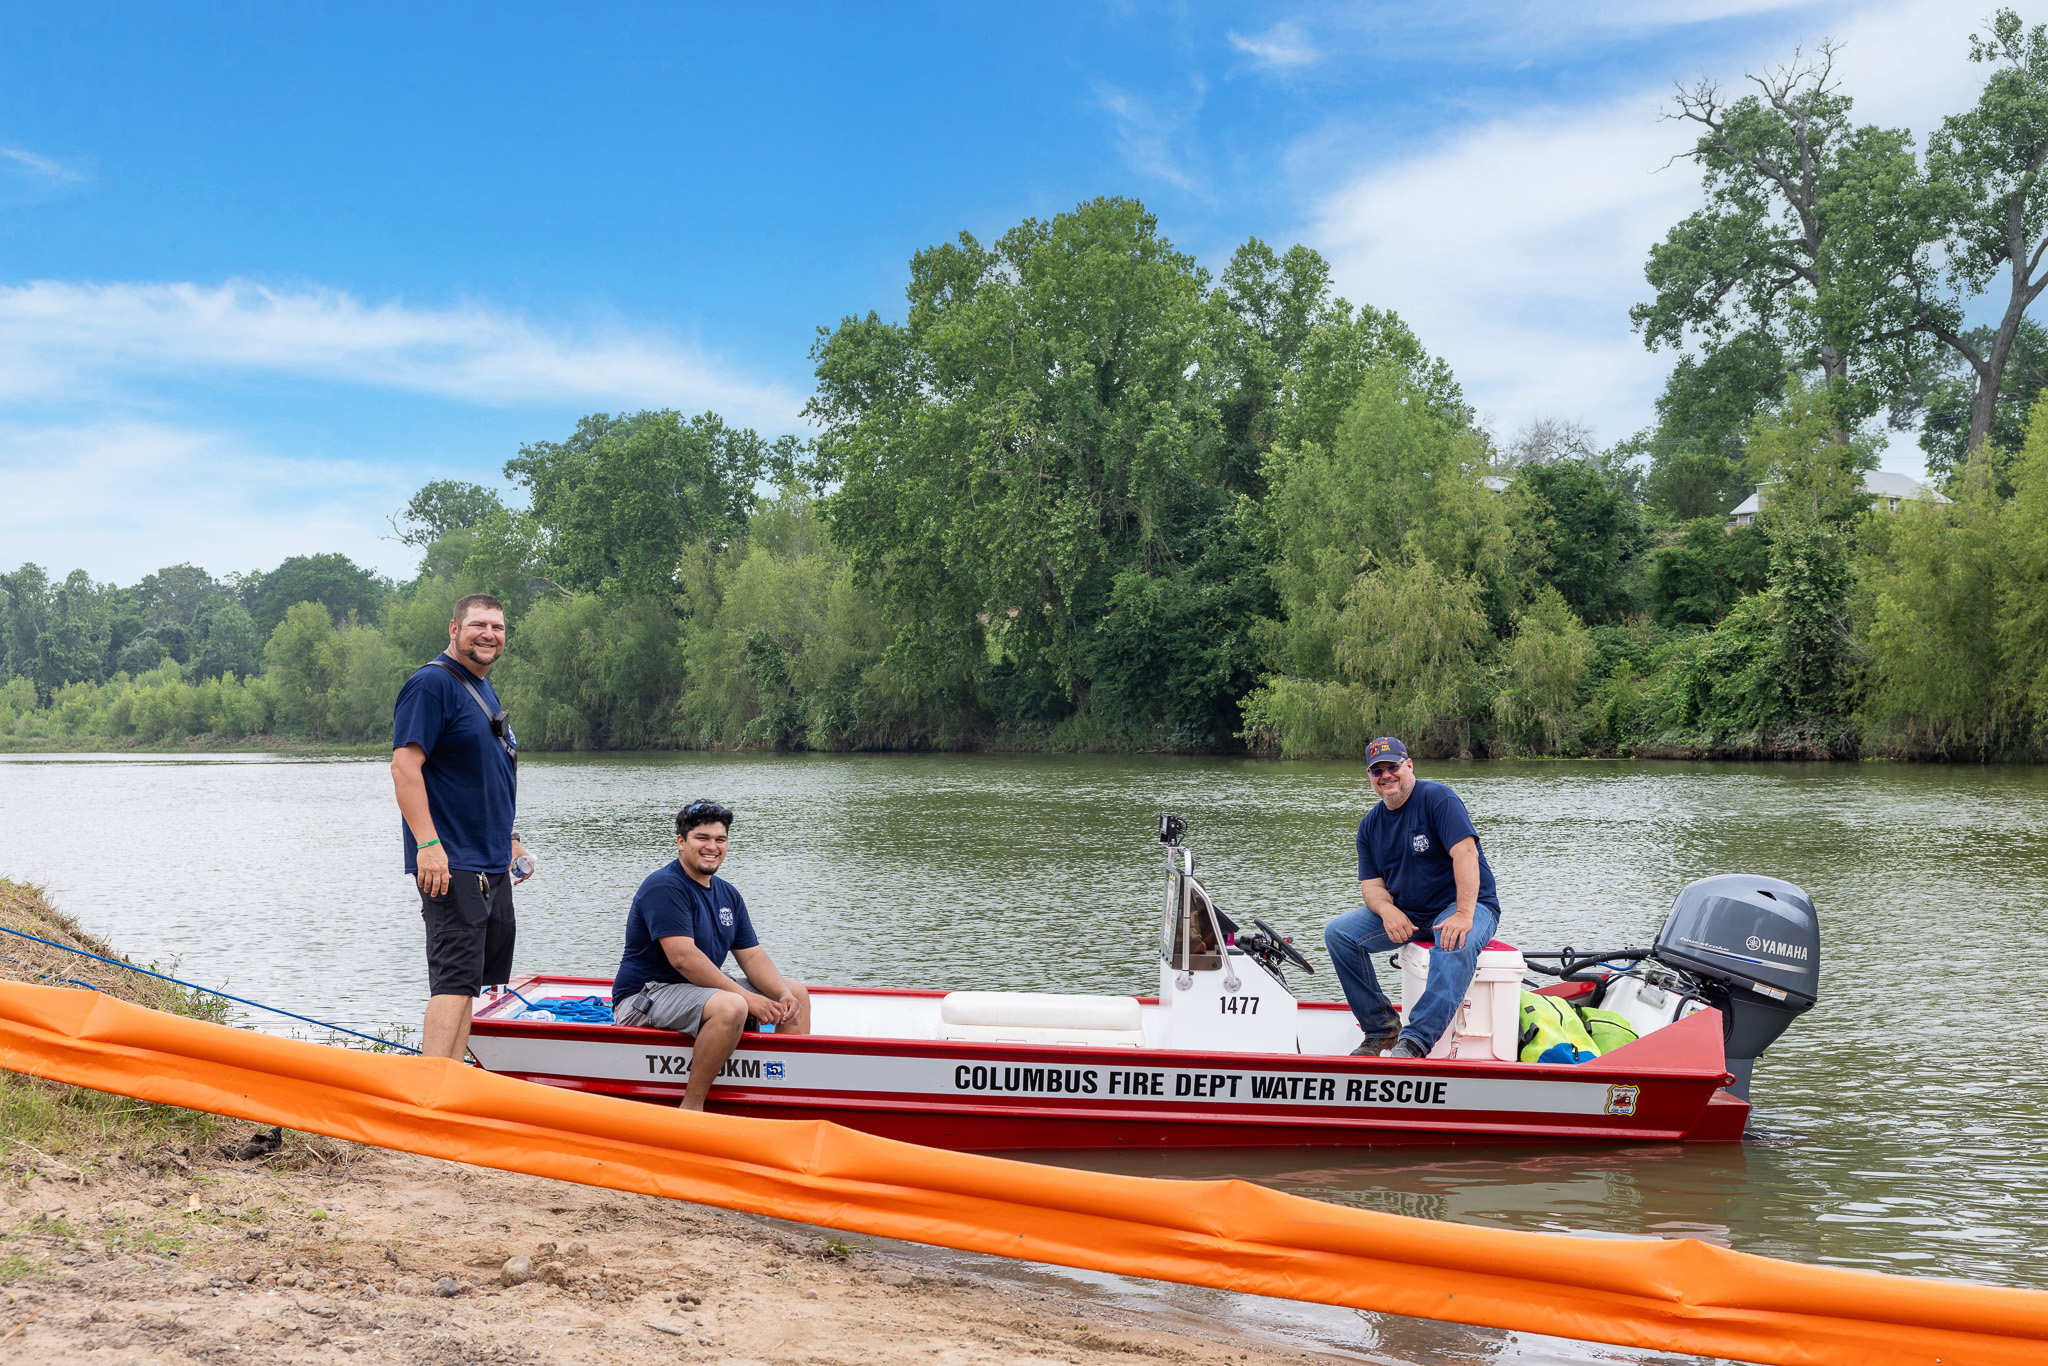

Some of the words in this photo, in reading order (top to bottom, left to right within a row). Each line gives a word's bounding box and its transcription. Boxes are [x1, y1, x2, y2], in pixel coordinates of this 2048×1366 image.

[1762, 939, 1808, 961] YAMAHA
[1219, 996, 1259, 1014] 1477
[770, 1064, 778, 1075] 5
[955, 1065, 1098, 1094] COLUMBUS
[1109, 1071, 1165, 1096] FIRE
[1175, 1074, 1242, 1098] DEPT
[1251, 1076, 1336, 1101] WATER
[1345, 1079, 1448, 1104] RESCUE
